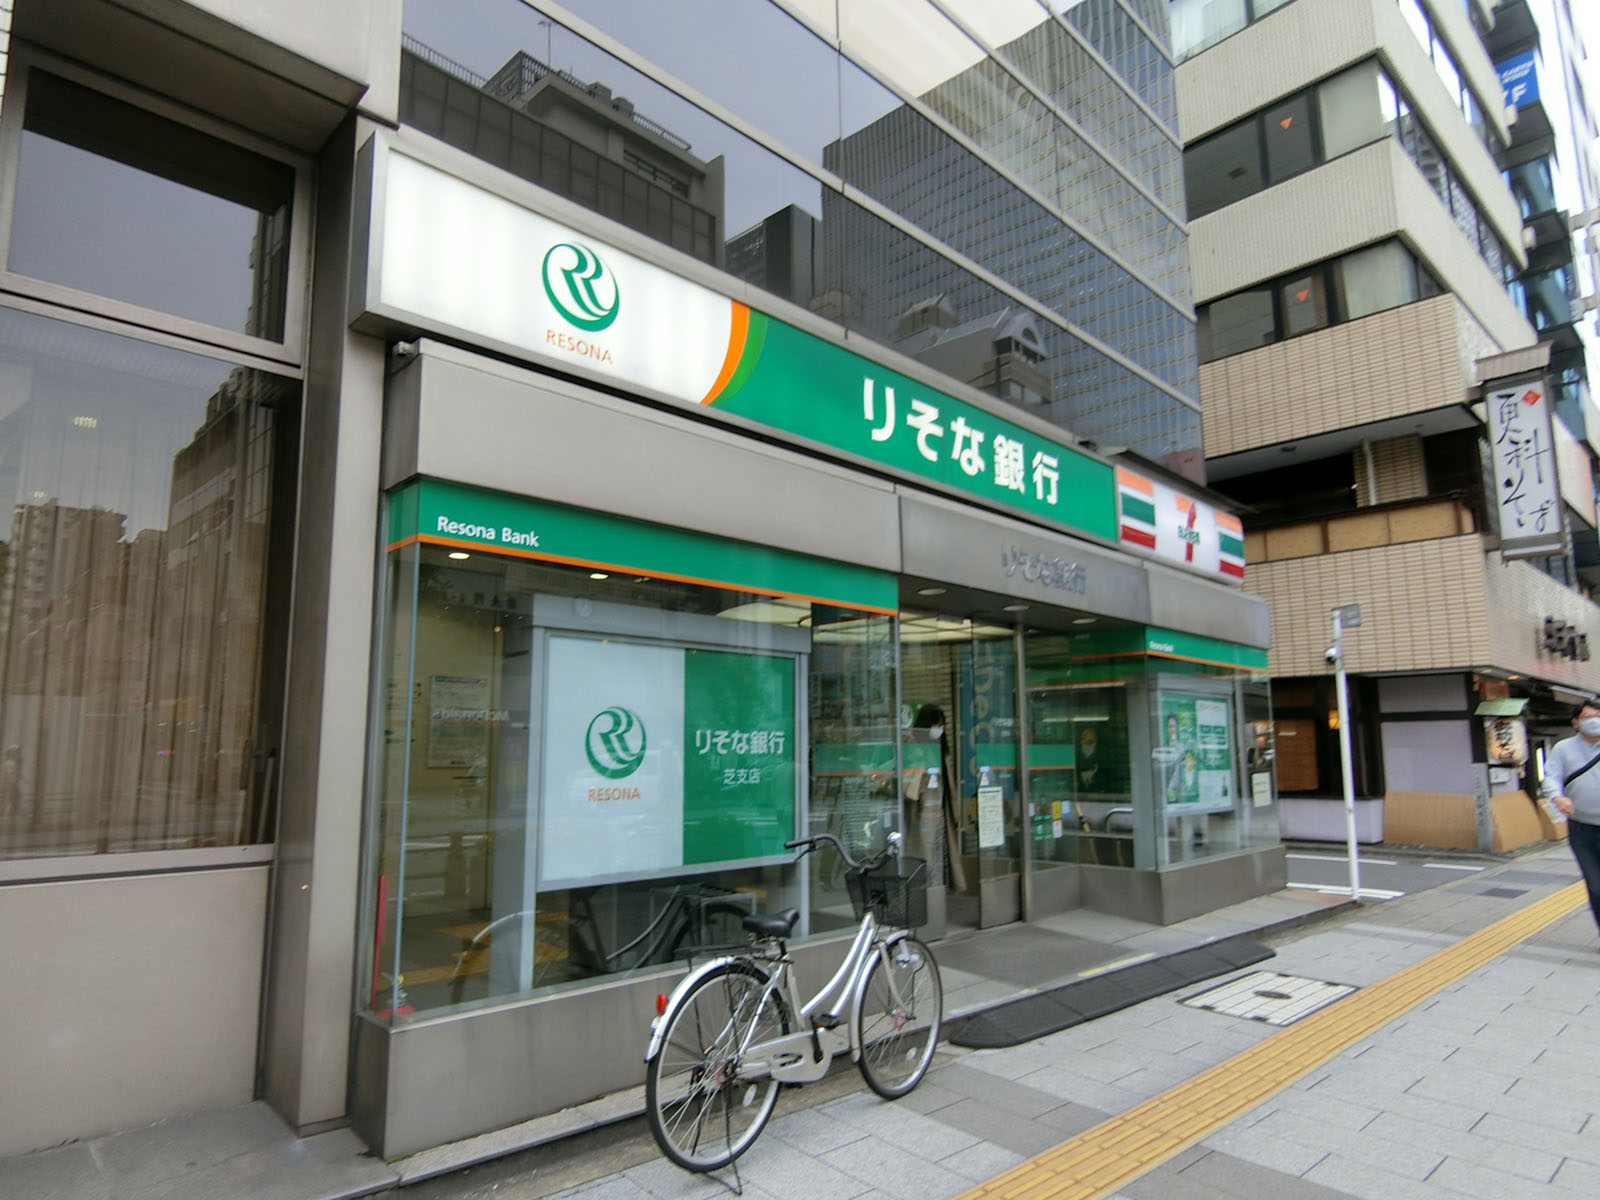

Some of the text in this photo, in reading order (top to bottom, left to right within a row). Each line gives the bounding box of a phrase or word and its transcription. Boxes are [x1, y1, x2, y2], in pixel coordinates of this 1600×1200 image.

[546, 329, 613, 365] RESONA
[863, 376, 1060, 505] りそな銀行
[437, 516, 540, 547] Resona Bank
[695, 729, 785, 755] りそな銀行
[723, 768, 761, 785] 芝支店
[587, 786, 641, 802] RESONA
